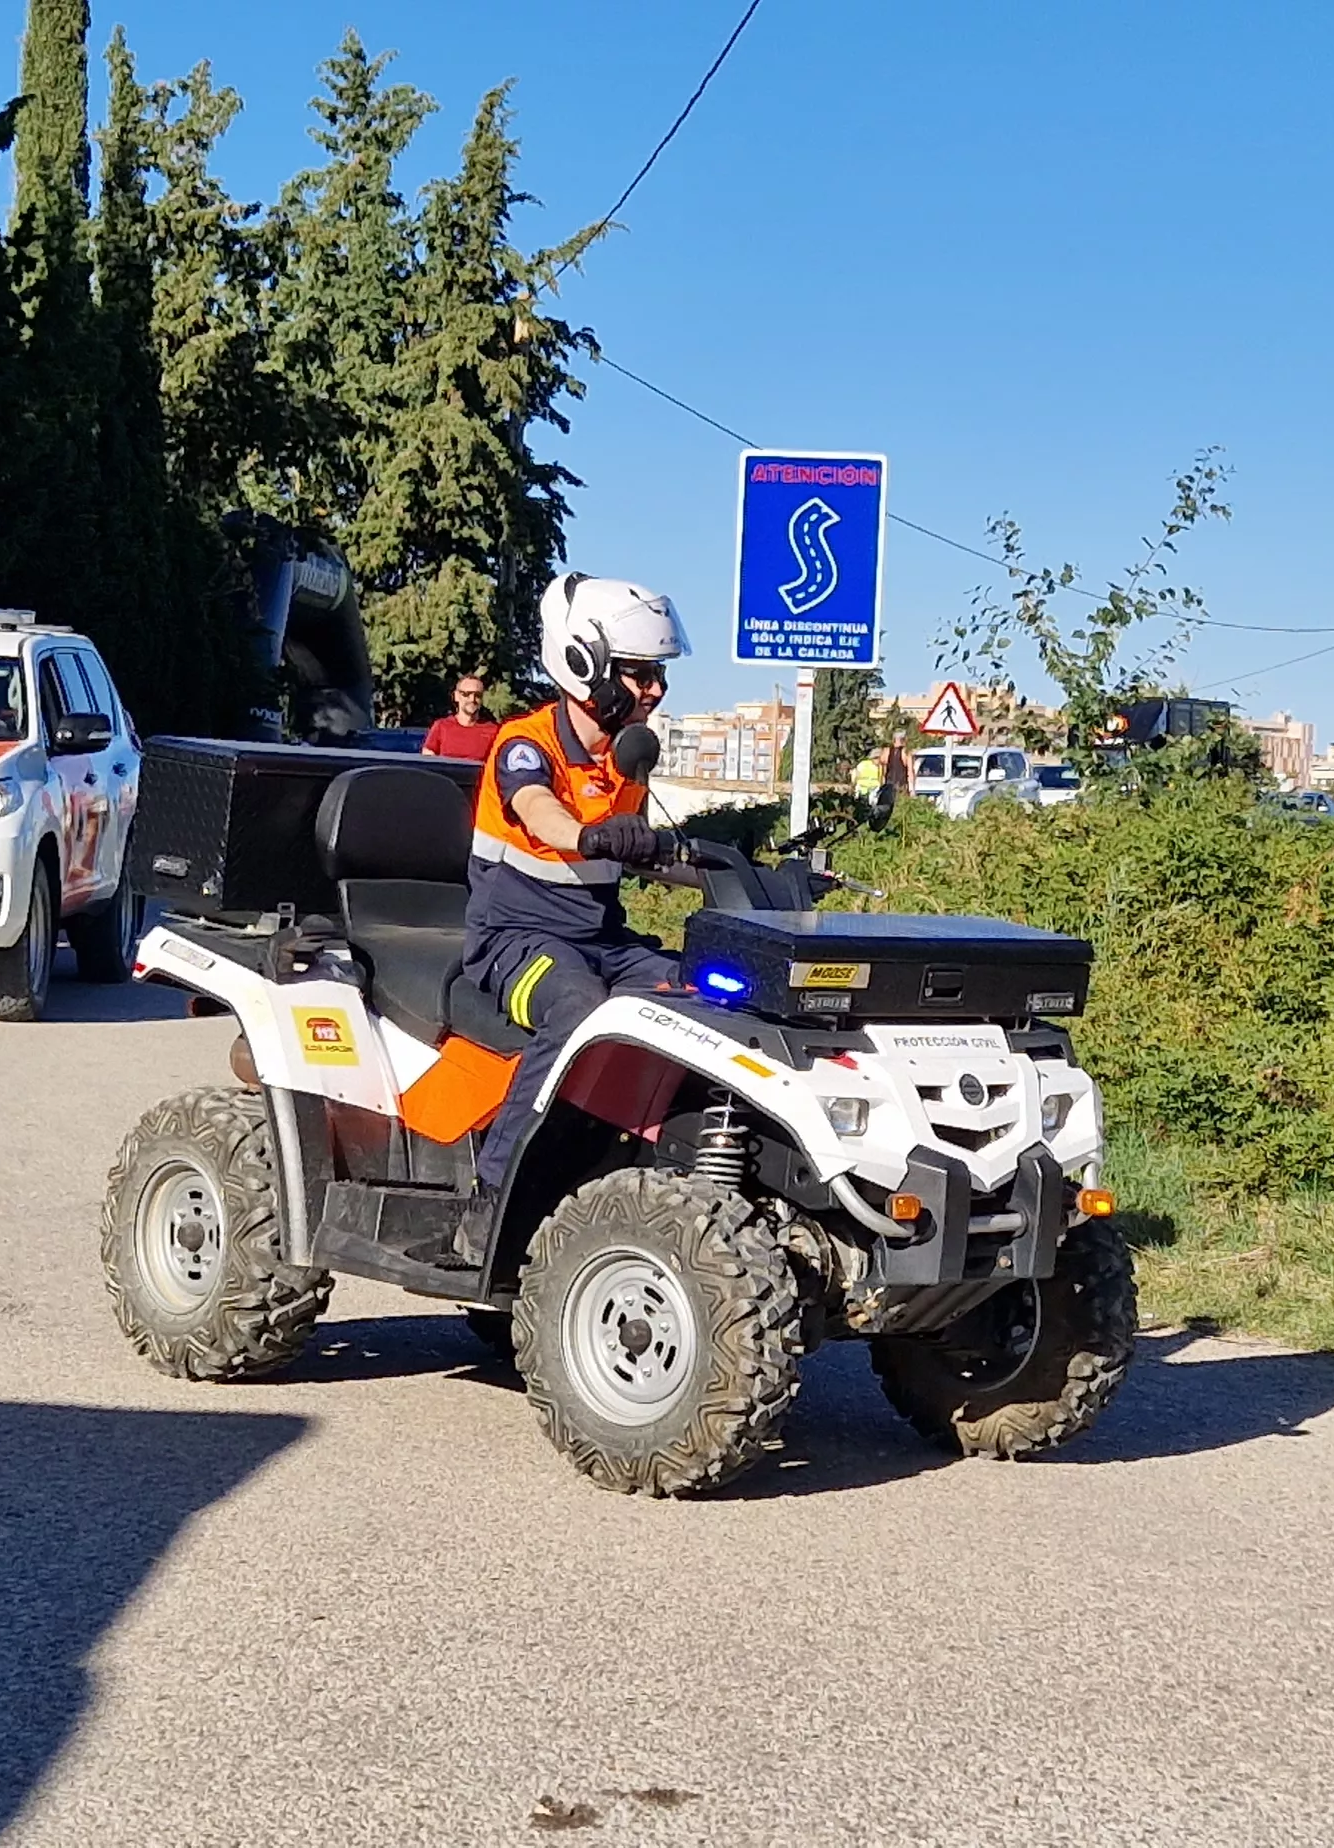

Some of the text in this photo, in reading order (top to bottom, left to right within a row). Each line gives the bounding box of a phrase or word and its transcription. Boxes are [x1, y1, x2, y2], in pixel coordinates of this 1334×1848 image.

[744, 617, 869, 634] LÍNEA DISCONTINUA
[751, 632, 860, 647] SÓLO INDICA EJE
[755, 646, 854, 659] DE LA CALZADA
[809, 966, 855, 979] MOOSE
[971, 1038, 1000, 1049] CIVIL
